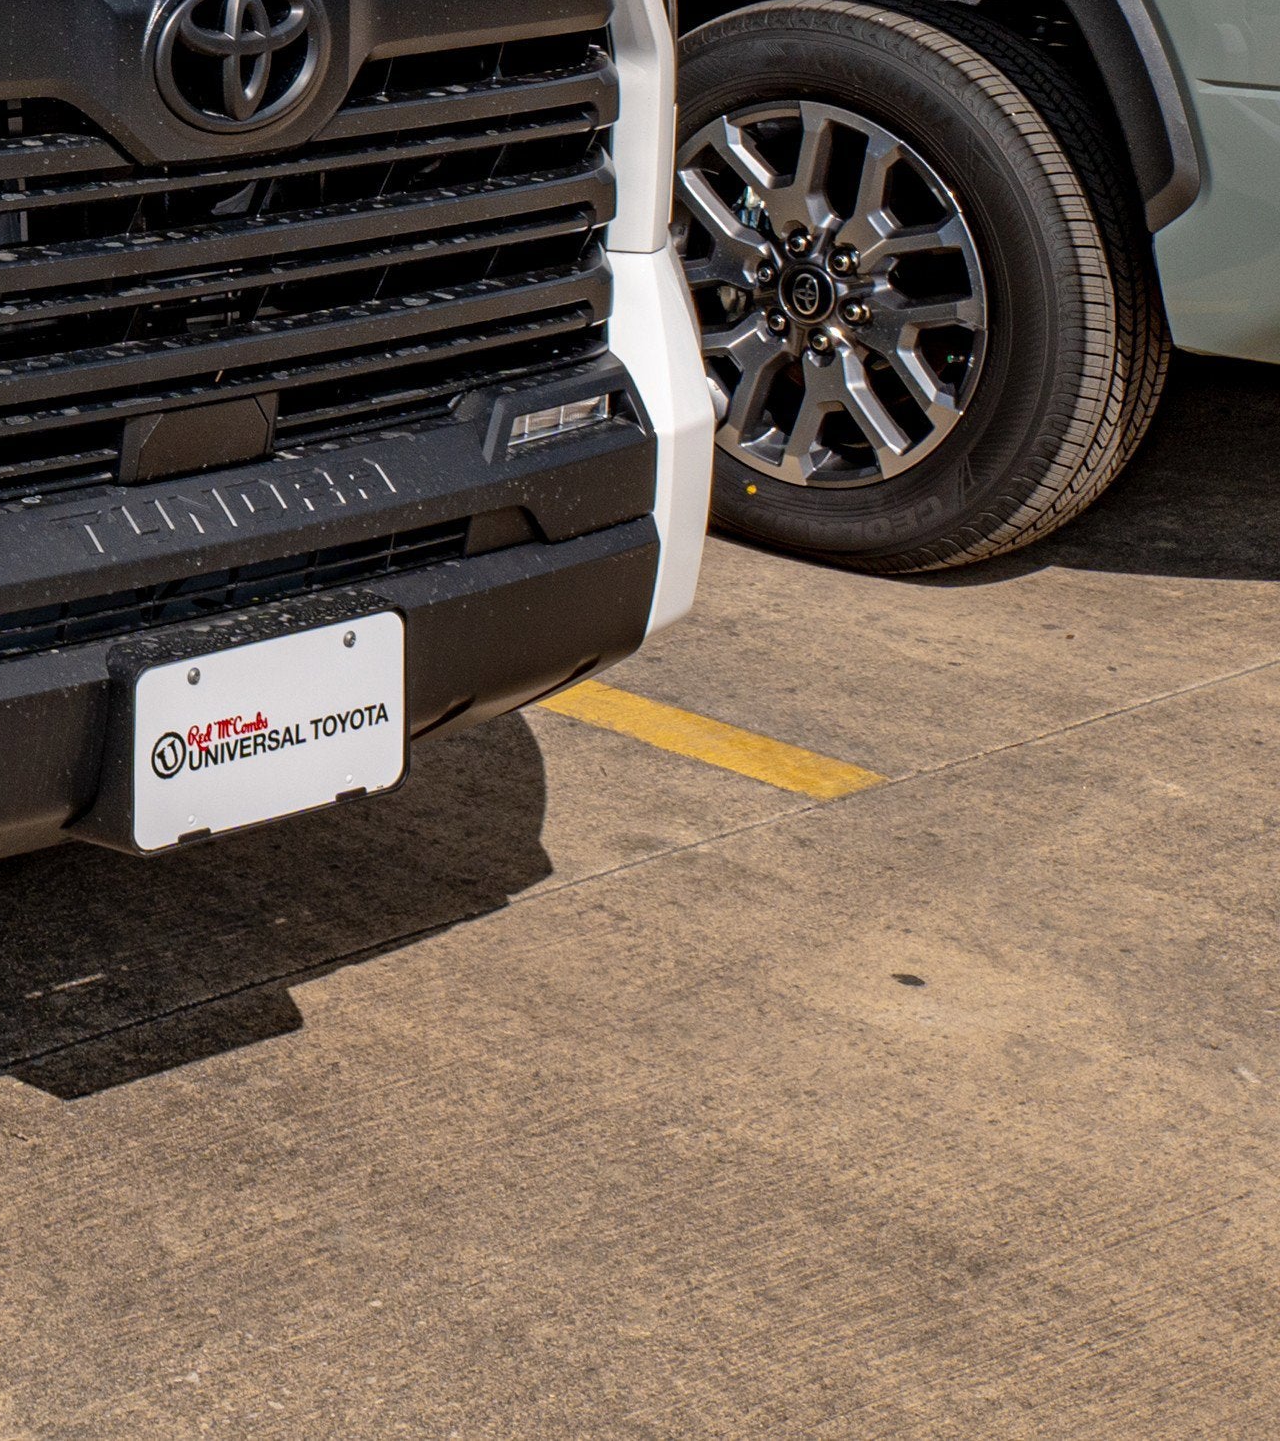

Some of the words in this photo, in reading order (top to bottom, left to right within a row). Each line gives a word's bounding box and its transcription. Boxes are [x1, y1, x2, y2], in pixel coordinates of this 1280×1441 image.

[48, 456, 397, 555] TUNDRA
[187, 724, 307, 772] UNIVERSAL
[310, 702, 389, 740] TOYOTA
[187, 723, 212, 752] Red
